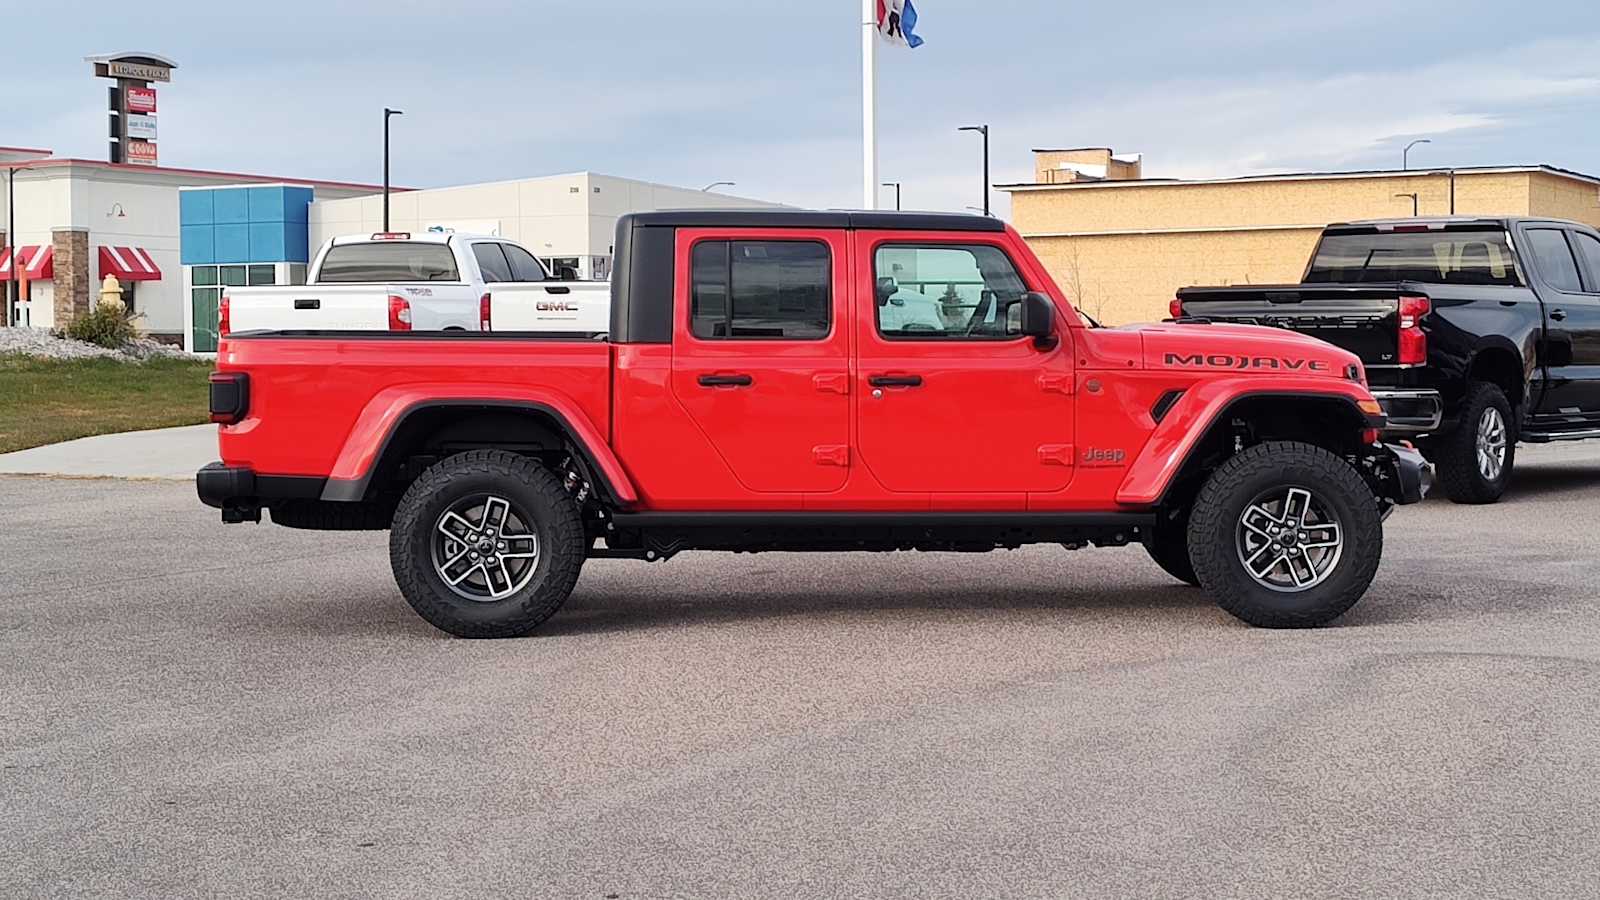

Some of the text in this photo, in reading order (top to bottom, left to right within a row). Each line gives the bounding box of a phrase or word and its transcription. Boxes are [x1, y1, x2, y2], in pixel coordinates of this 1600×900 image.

[536, 302, 578, 311] GMC
[1164, 353, 1330, 371] MOJAVE
[1083, 447, 1126, 463] Jeep
